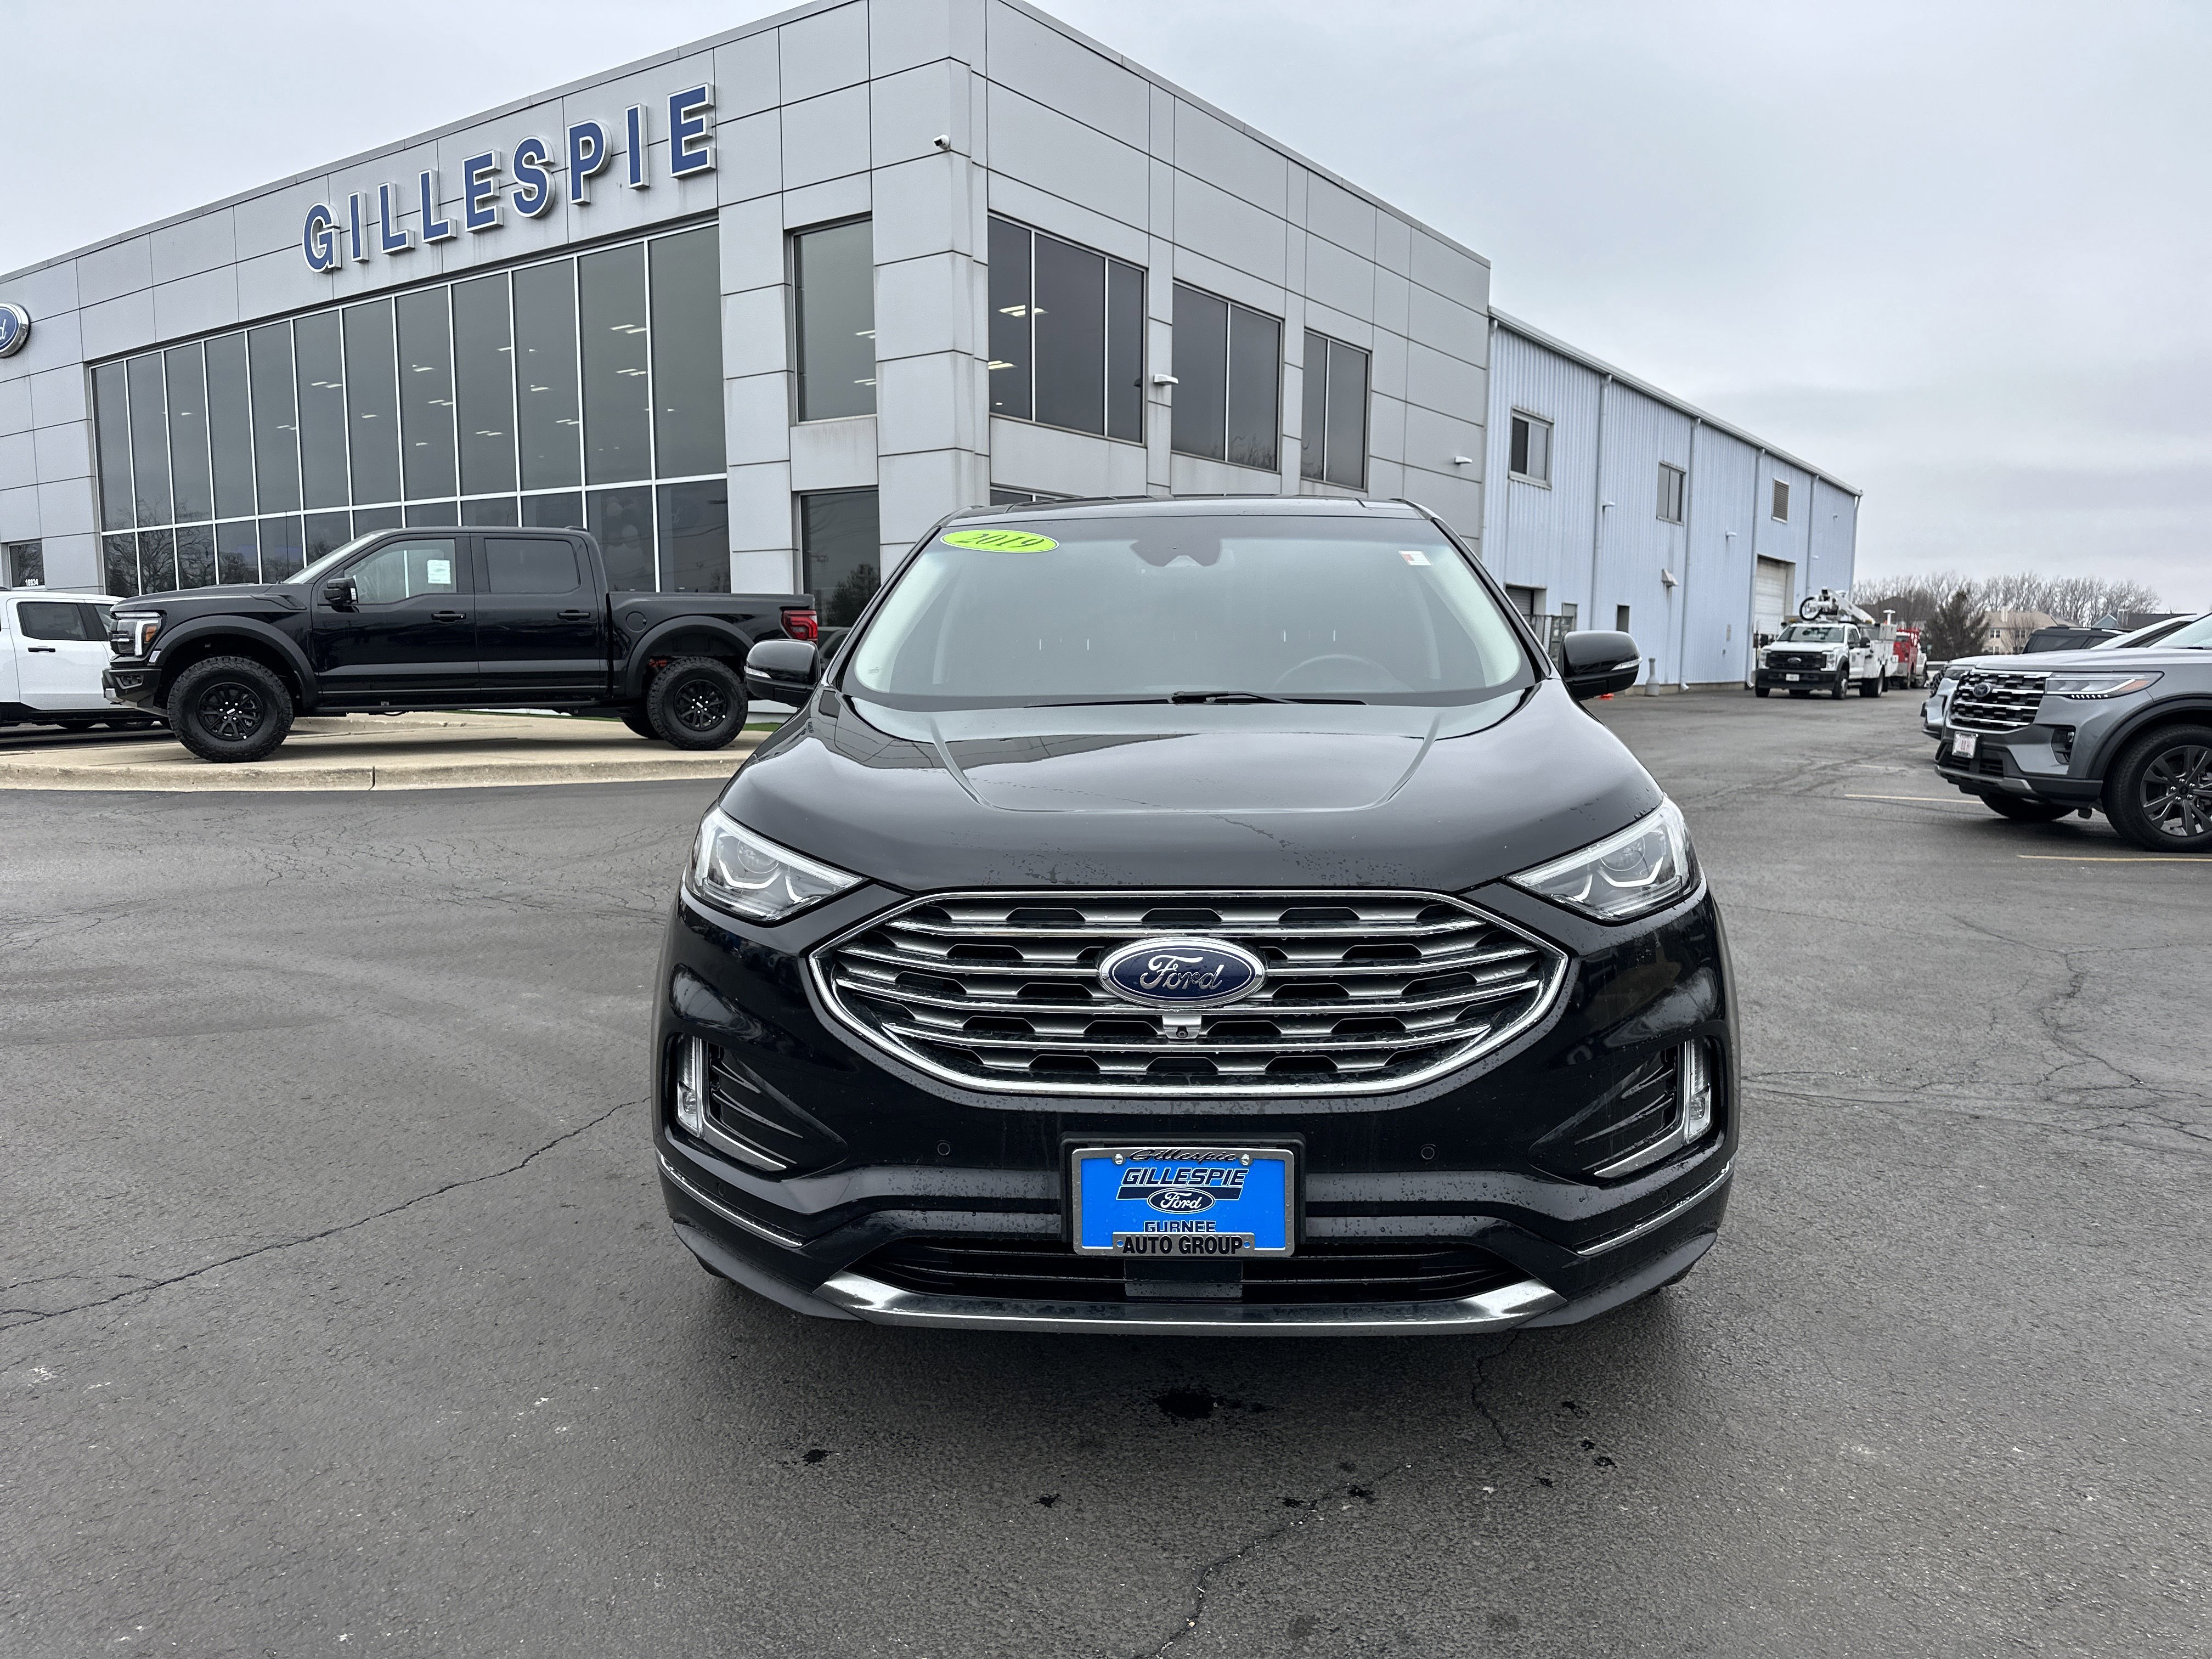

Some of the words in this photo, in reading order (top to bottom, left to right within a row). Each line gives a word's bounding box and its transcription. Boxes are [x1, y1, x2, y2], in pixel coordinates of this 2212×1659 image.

[302, 83, 716, 273] GILLESPIE
[954, 533, 1045, 548] 2019
[1139, 955, 1224, 990] Ford
[1130, 1149, 1236, 1164] Gillespie
[1121, 1167, 1249, 1186] GILLESPIE
[1160, 1192, 1203, 1209] Ford
[1143, 1220, 1216, 1233] GURNEE
[1122, 1235, 1172, 1254] AUTO
[1178, 1235, 1243, 1254] GROUP
